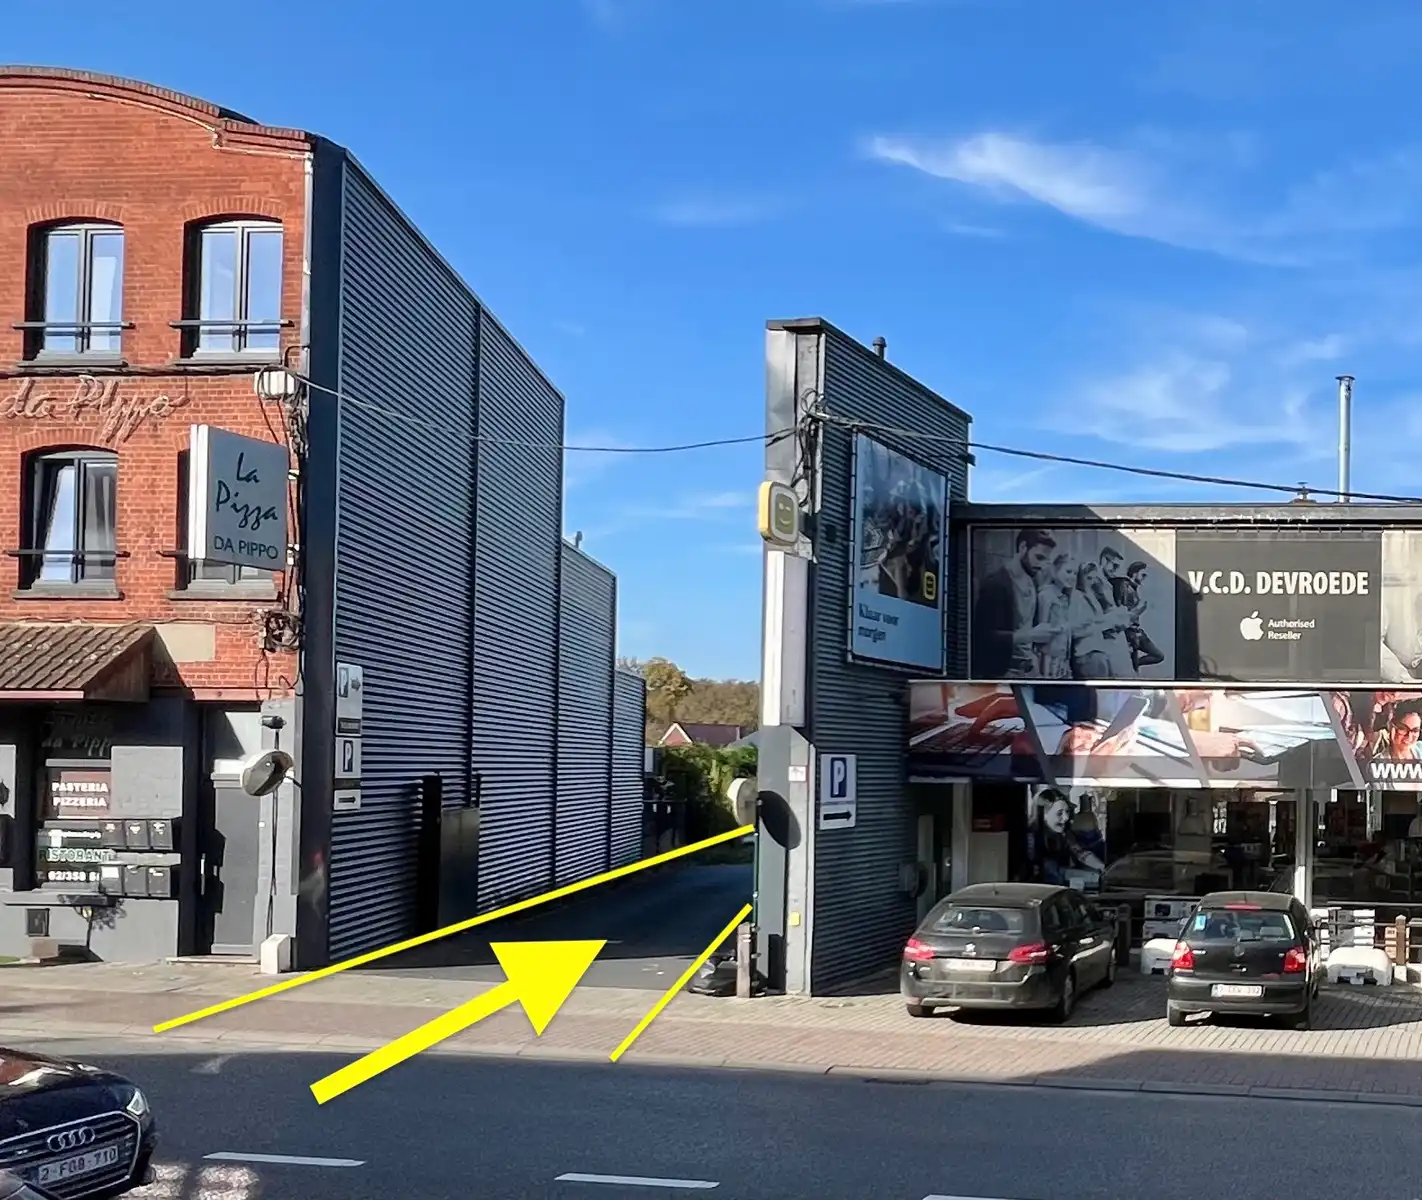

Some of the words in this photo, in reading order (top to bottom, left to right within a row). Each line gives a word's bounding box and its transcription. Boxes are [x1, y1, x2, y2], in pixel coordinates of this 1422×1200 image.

[236, 452, 260, 483] La
[215, 479, 278, 531] Pizza
[214, 535, 235, 554] DA
[238, 540, 279, 560] PIPPO
[1188, 570, 1251, 595] V.C.D.
[1256, 571, 1369, 595] DEVROEDE
[1268, 618, 1315, 629] Authorised
[1268, 630, 1302, 640] Reseller
[51, 782, 109, 793] PASTERIA
[833, 760, 845, 795] P
[52, 796, 107, 807] PIZZERIA
